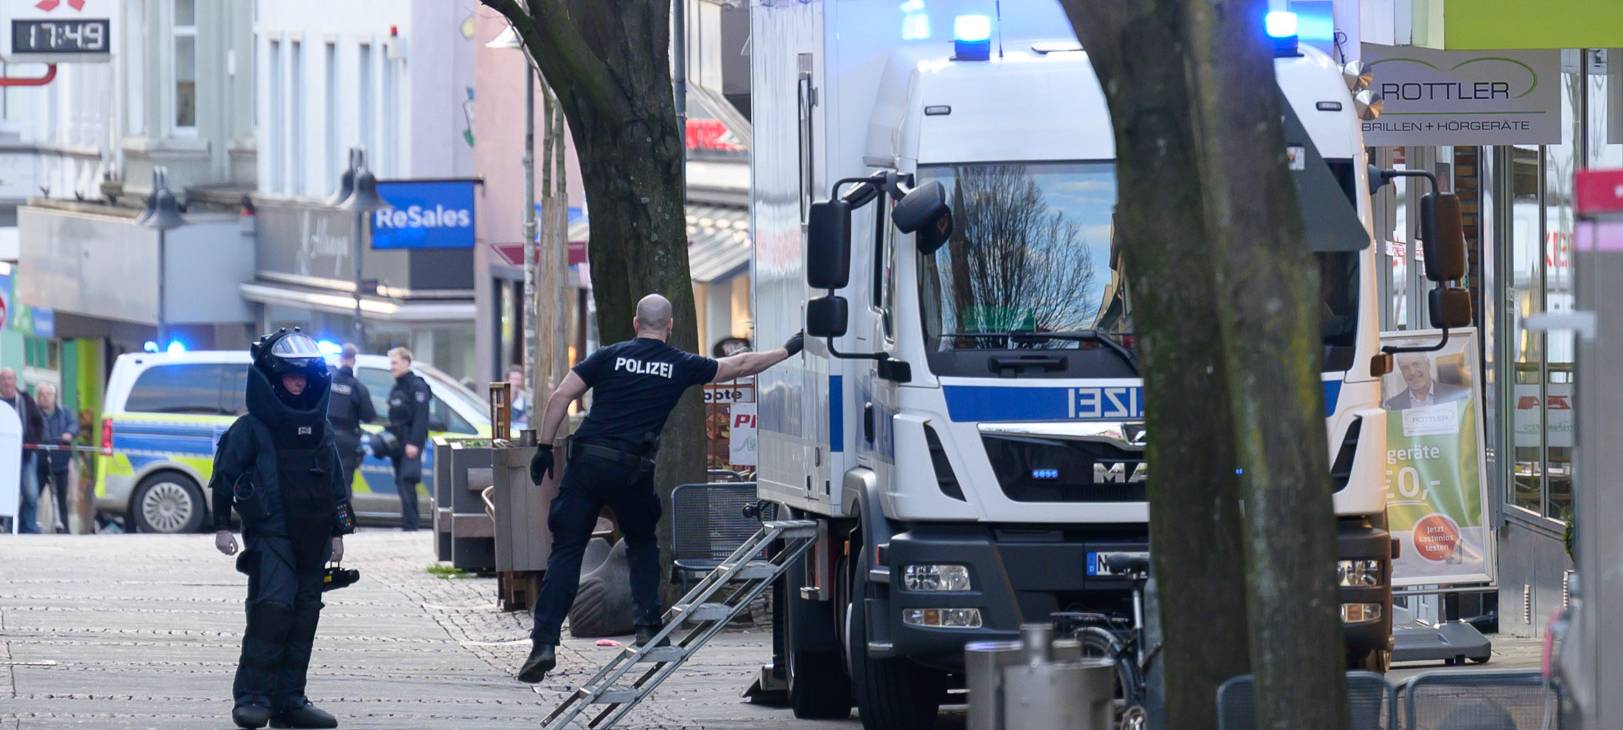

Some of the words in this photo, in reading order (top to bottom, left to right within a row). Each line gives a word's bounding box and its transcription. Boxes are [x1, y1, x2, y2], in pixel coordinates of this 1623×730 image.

[30, 23, 103, 49] 17:49
[1381, 82, 1509, 101] ROTTLER
[1361, 122, 1422, 132] BRILLEN
[1438, 120, 1530, 132] HÖRGERÄTE
[376, 203, 471, 229] ReSales
[614, 357, 673, 379] POLIZEI
